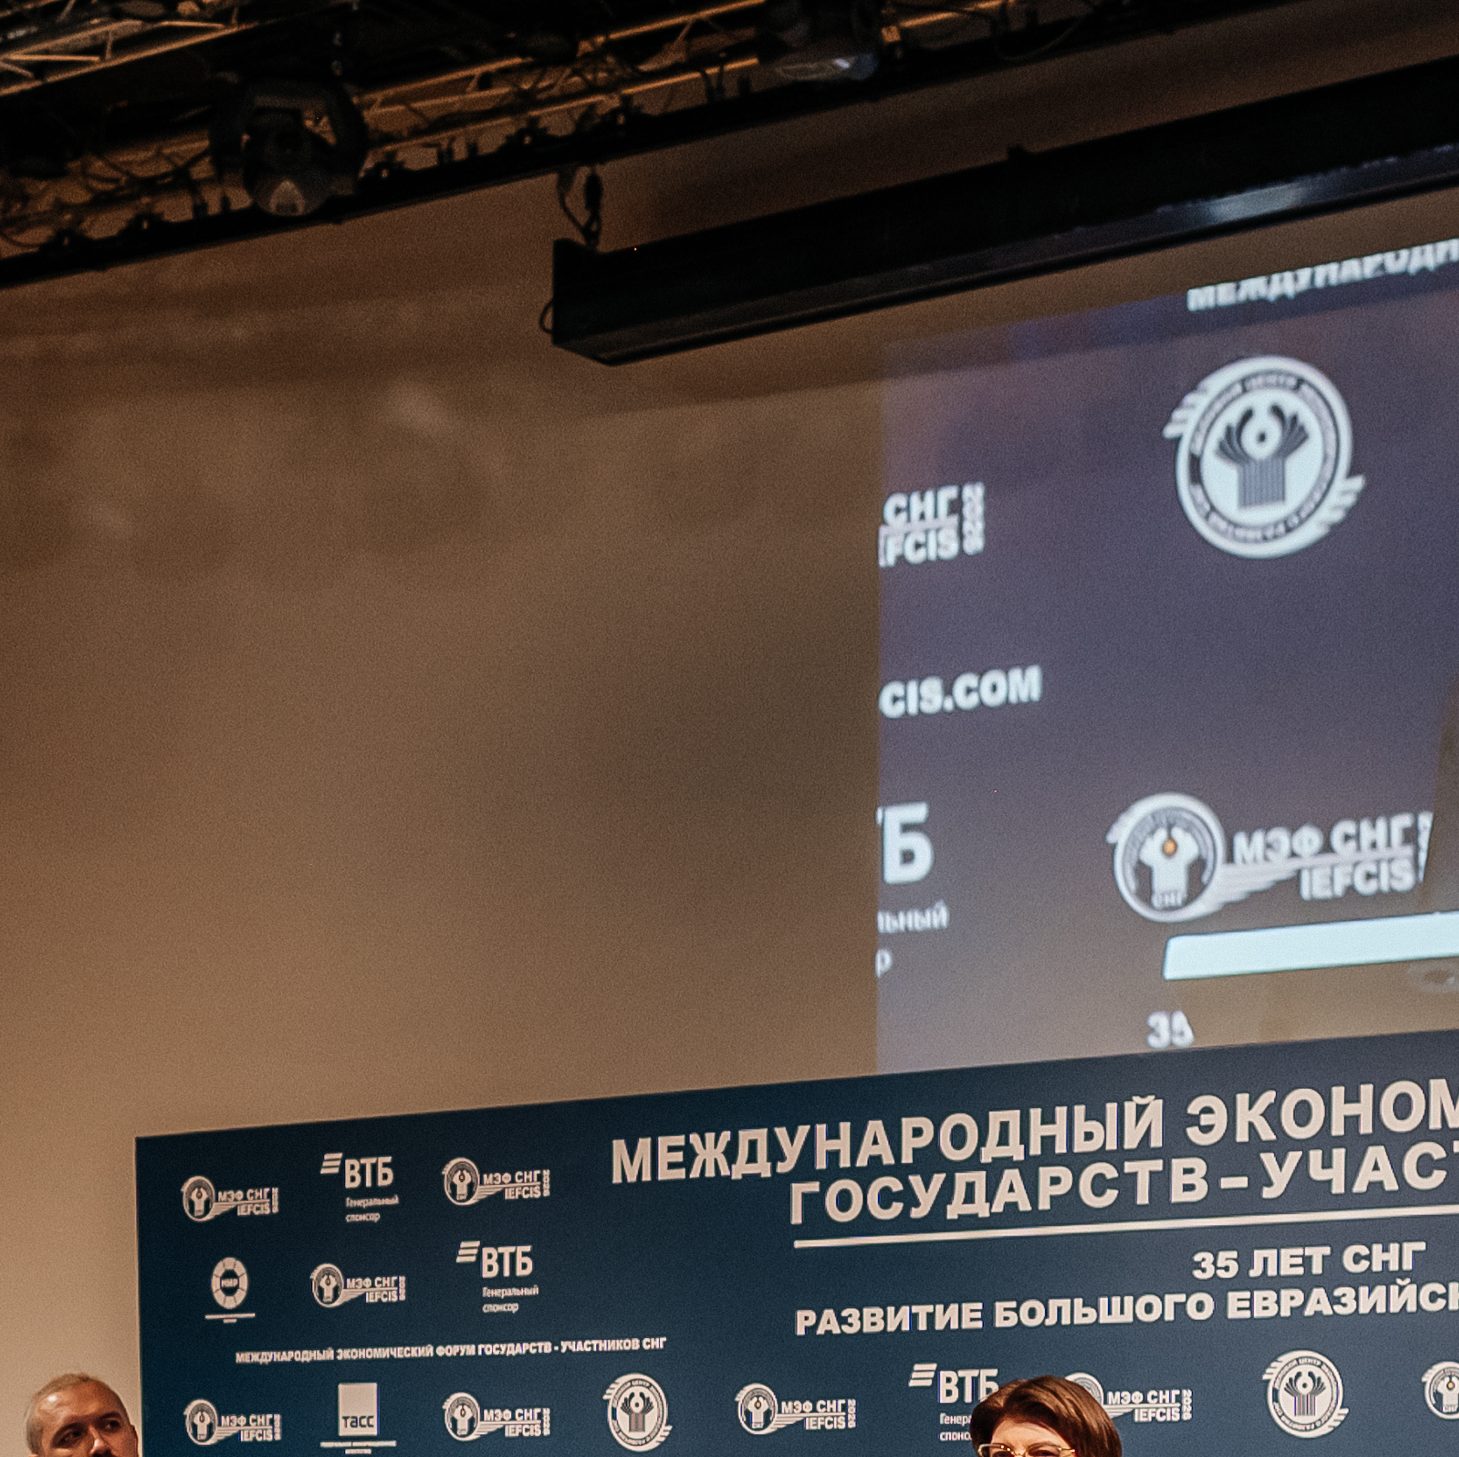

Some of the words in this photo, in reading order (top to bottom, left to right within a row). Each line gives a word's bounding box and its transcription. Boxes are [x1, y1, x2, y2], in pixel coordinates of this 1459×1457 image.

[1233, 826, 1323, 863] МЭФ
[1330, 813, 1413, 852] СНГ
[1299, 858, 1414, 891] IEFCIS
[611, 1095, 1164, 1184] МЕЖДУНАРОДНЫЙ
[344, 1156, 393, 1188] ВТБ
[483, 1172, 511, 1185] МЭФ
[515, 1170, 541, 1183] СНГ
[505, 1185, 541, 1199] IEFCIS
[481, 1245, 533, 1278] ВТБ
[1193, 1251, 1239, 1280] 35
[1249, 1246, 1331, 1277] ЛЕТ
[1342, 1241, 1426, 1273] СНГ
[375, 1276, 398, 1288] СНГ
[796, 1302, 983, 1335] РАЗВИТИЕ
[994, 1292, 1215, 1328] БОЛЬШОГО
[235, 1347, 335, 1364] МЕЖДУНАРОДНЫЙ
[336, 1345, 434, 1360] ЭКОНОМИЧЕСКИЙ
[436, 1344, 476, 1358] ФОРУМ
[477, 1342, 552, 1357] ГОСУДАРСТВ
[560, 1339, 641, 1353] УЧАСТНИКОВ
[642, 1337, 667, 1350] СНГ
[1107, 1391, 1144, 1405] МЭФ
[1146, 1389, 1181, 1404] СНГ
[781, 1401, 813, 1414] МЭФ
[816, 1399, 846, 1413] СНГ
[249, 1414, 273, 1426] СНГ
[483, 1409, 512, 1421] МЭФ
[515, 1408, 542, 1421] СНГ
[1134, 1407, 1181, 1422] IEFCIS
[504, 1423, 541, 1437] IEFCIS
[804, 1416, 846, 1430] IEFCIS
